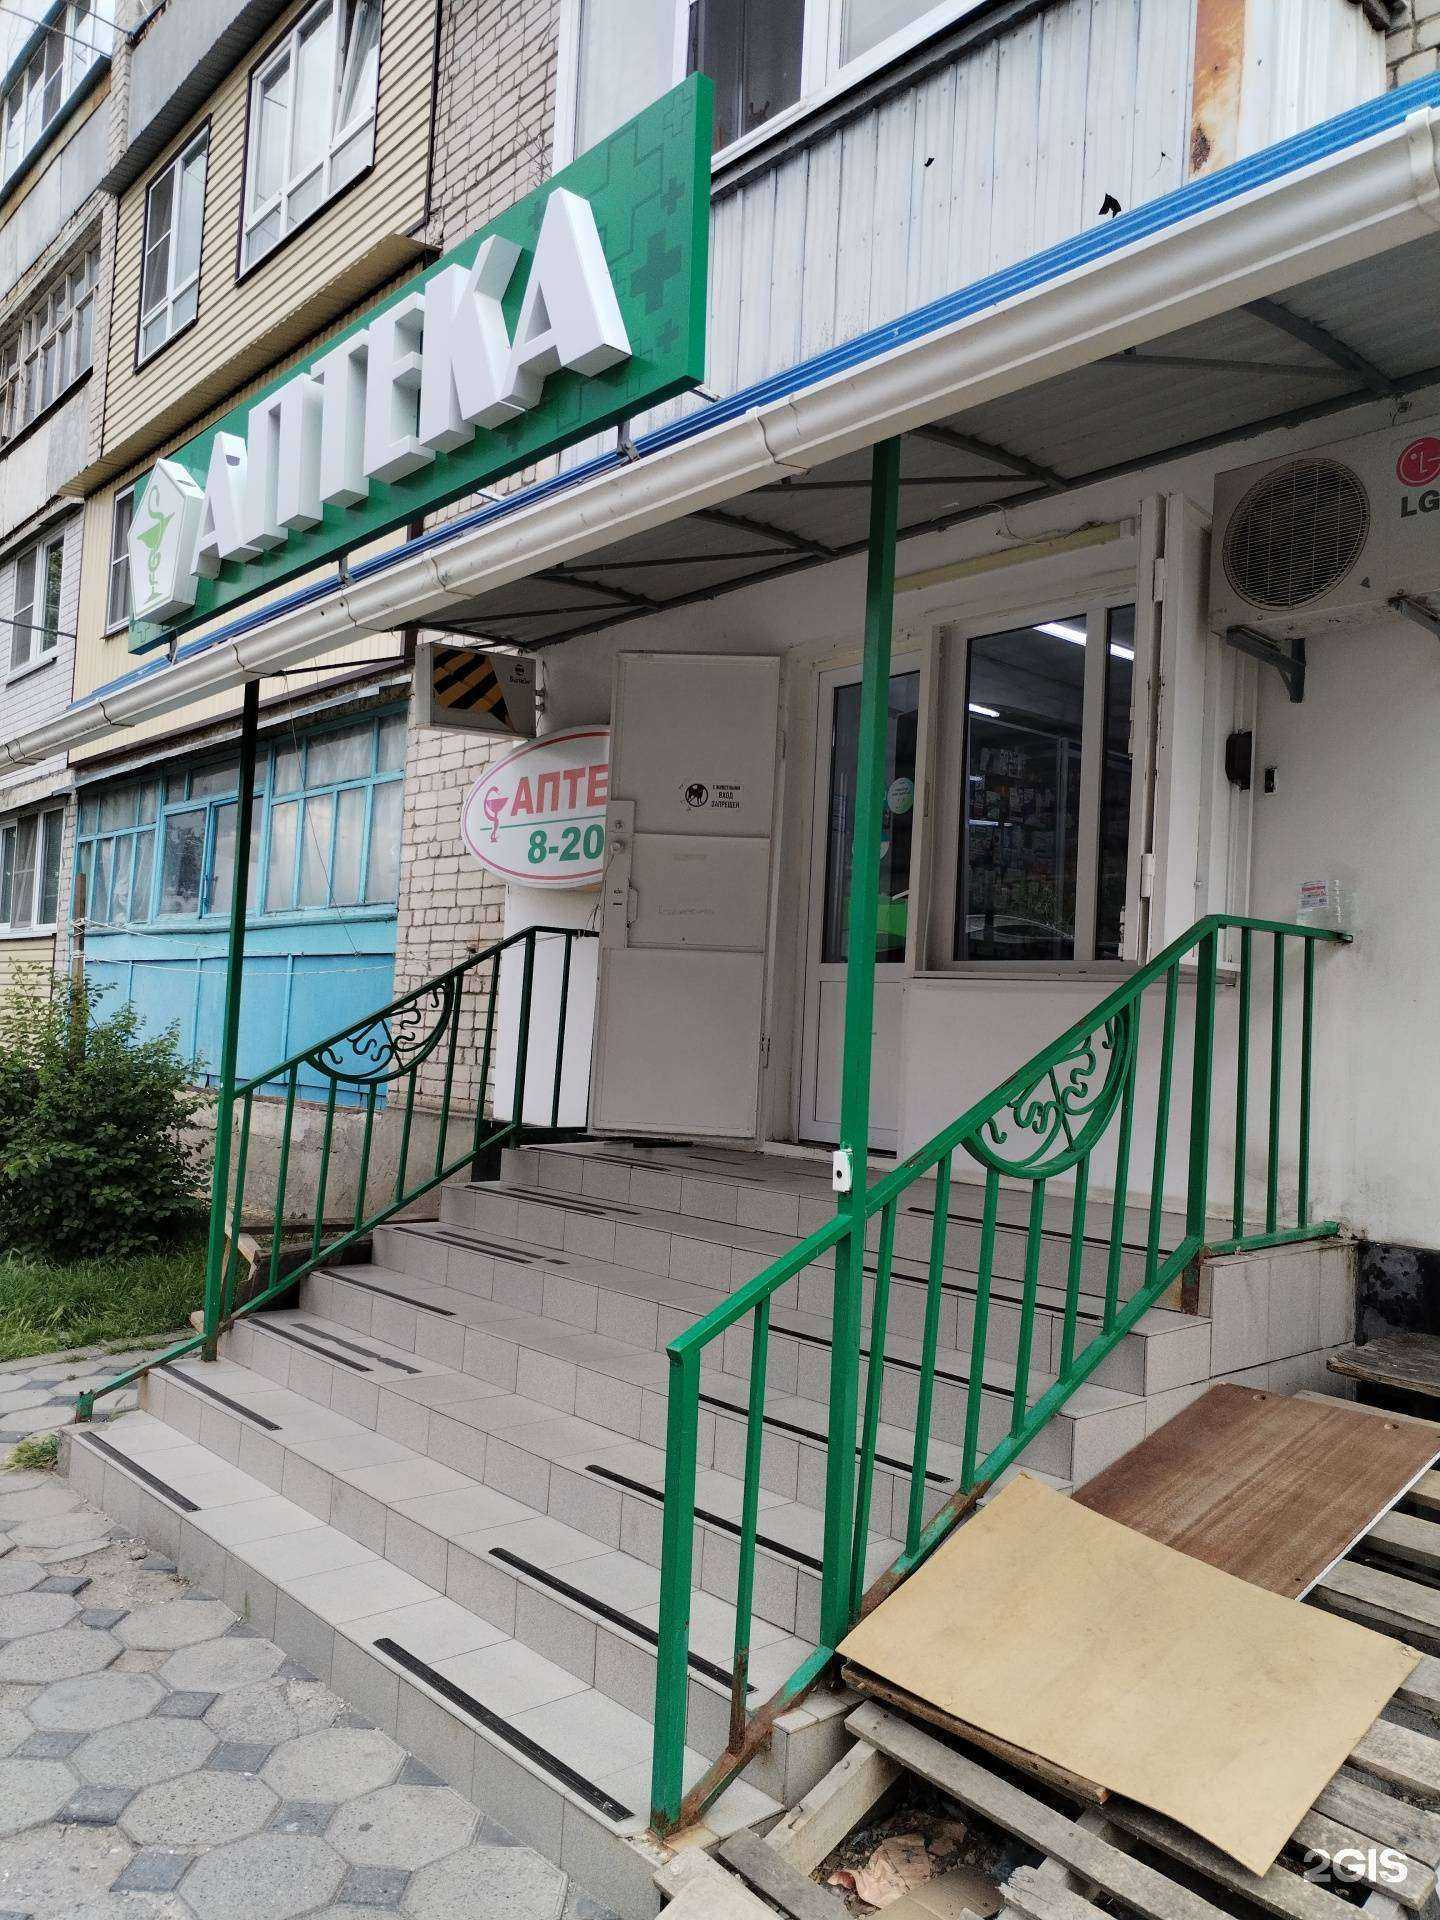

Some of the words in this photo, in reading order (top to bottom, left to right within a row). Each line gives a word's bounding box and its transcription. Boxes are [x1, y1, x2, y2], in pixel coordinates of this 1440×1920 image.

[191, 187, 632, 580] АПТЕКА
[1401, 490, 1440, 518] LG
[719, 791, 734, 800] ВХОД
[527, 823, 605, 864] 8-20
